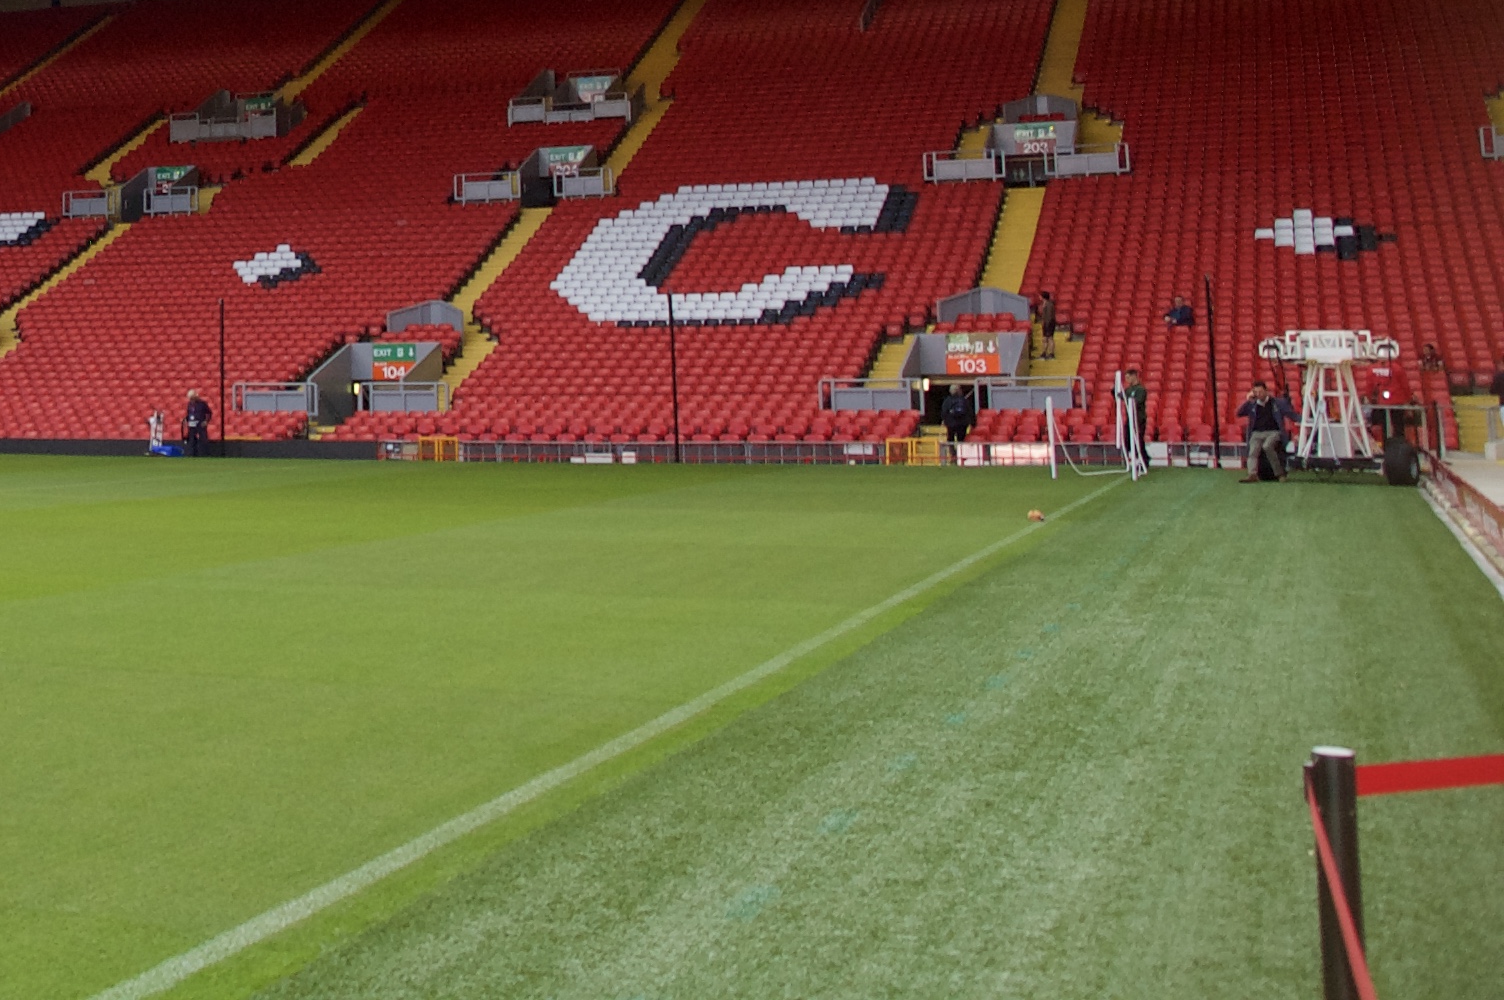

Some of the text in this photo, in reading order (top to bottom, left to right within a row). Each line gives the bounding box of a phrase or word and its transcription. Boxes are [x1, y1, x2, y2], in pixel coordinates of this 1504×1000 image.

[373, 349, 392, 357] EXIT
[381, 366, 405, 379] 104
[957, 359, 987, 373] 103
